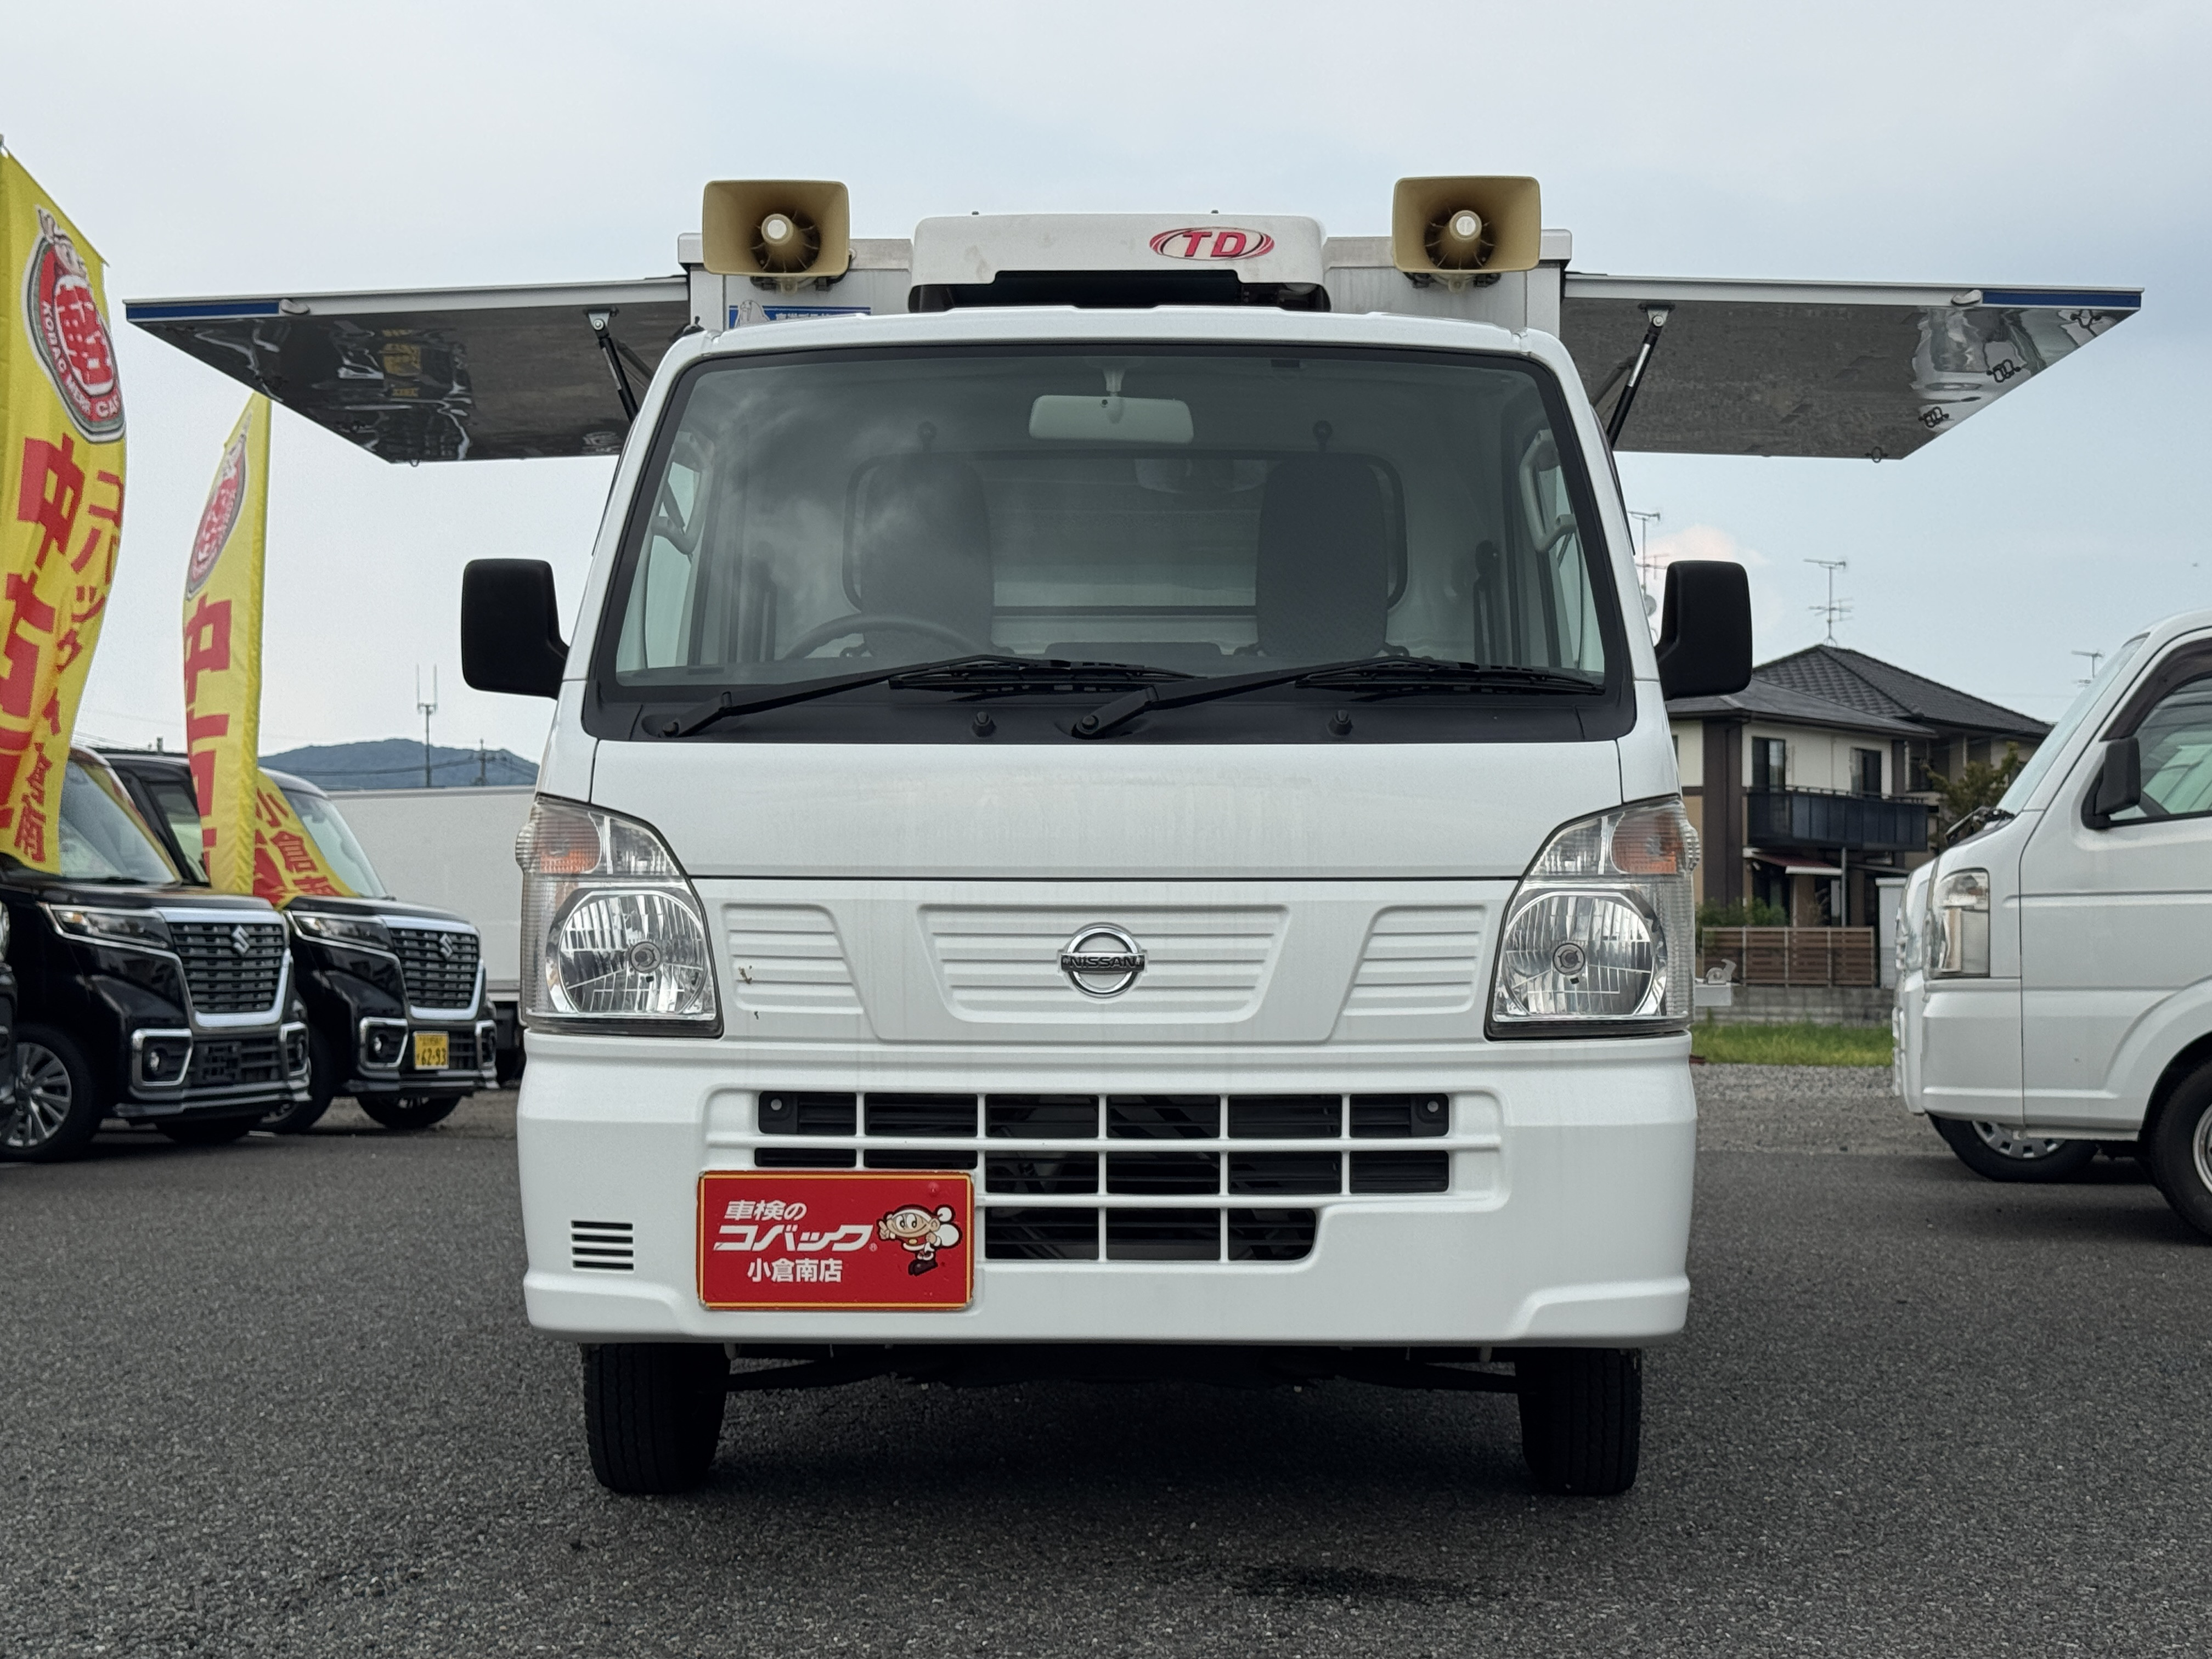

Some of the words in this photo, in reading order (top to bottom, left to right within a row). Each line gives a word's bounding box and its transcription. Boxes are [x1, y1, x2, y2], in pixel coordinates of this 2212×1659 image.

[1183, 231, 1246, 257] TD
[1070, 956, 1137, 968] NISSAN
[724, 1199, 808, 1221] 車検の
[713, 1224, 874, 1252] コバック
[747, 1257, 843, 1283] 小倉南店
